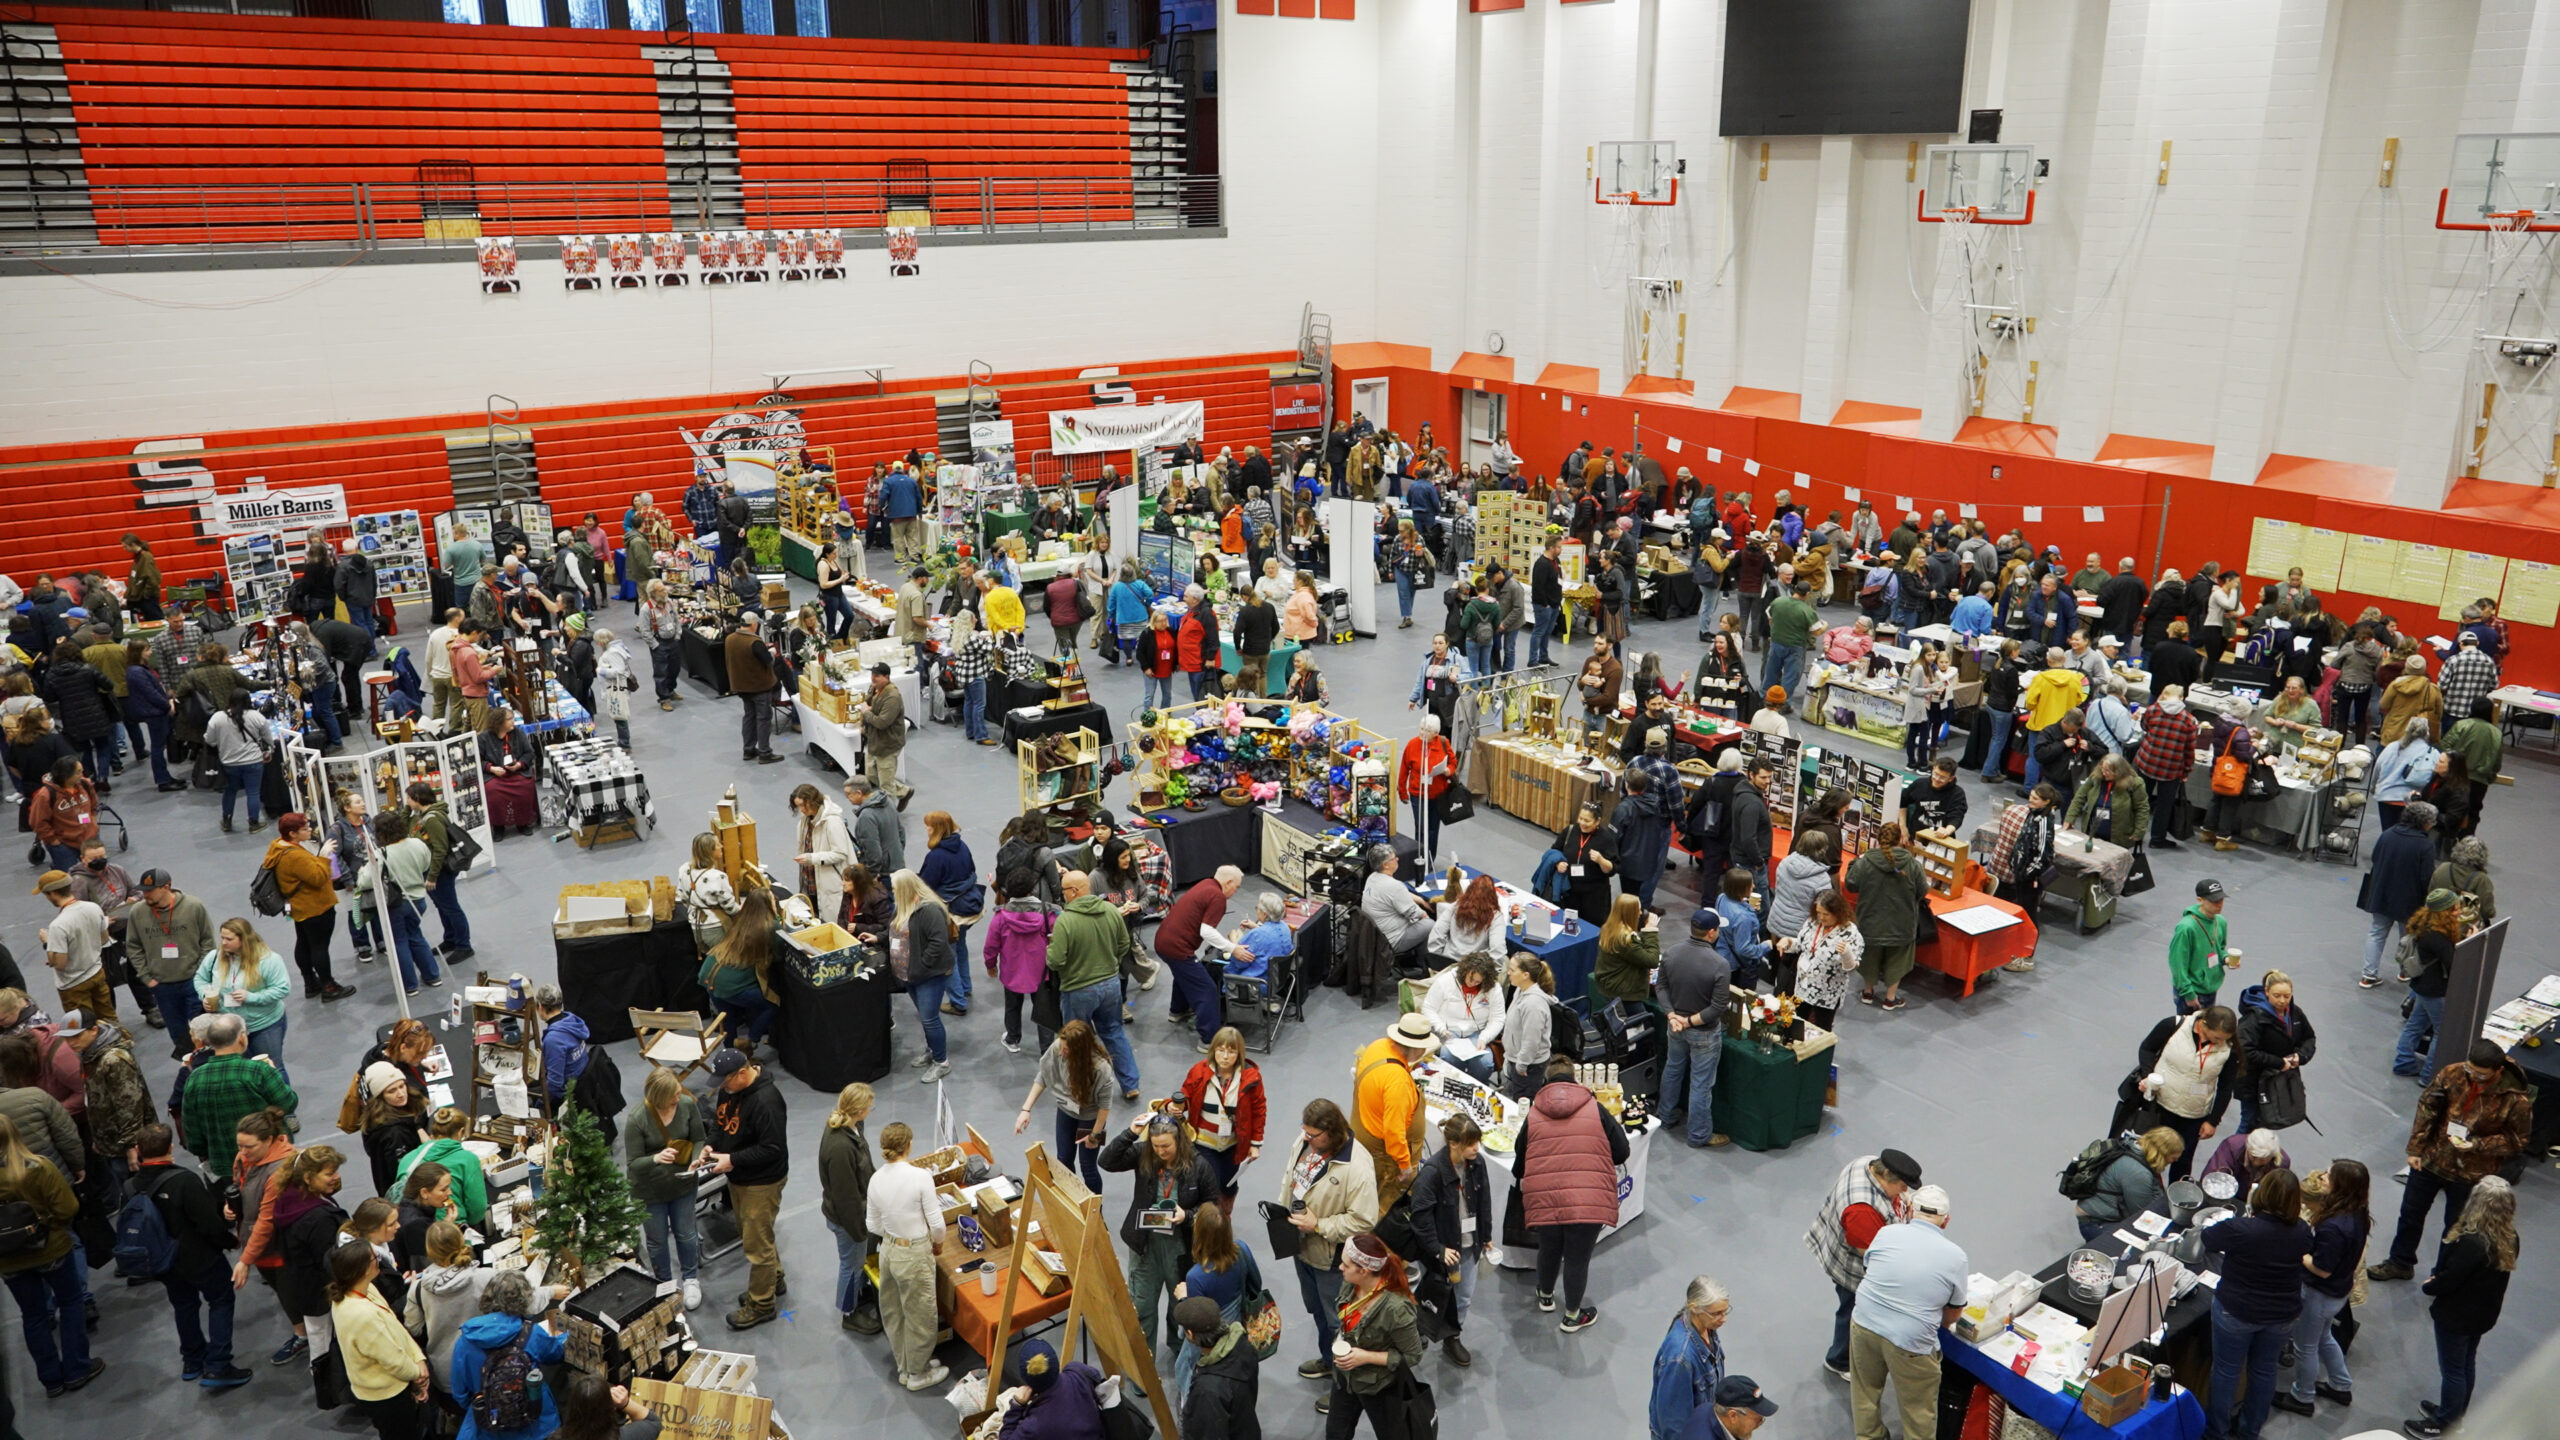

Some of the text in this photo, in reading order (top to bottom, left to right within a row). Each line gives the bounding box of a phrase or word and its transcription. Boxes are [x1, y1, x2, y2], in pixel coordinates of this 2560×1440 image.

[1292, 399, 1304, 407] LIVE
[1084, 420, 1158, 437] SNOHOMISH
[228, 499, 334, 520] Miller Barns
[689, 1403, 732, 1438] design
